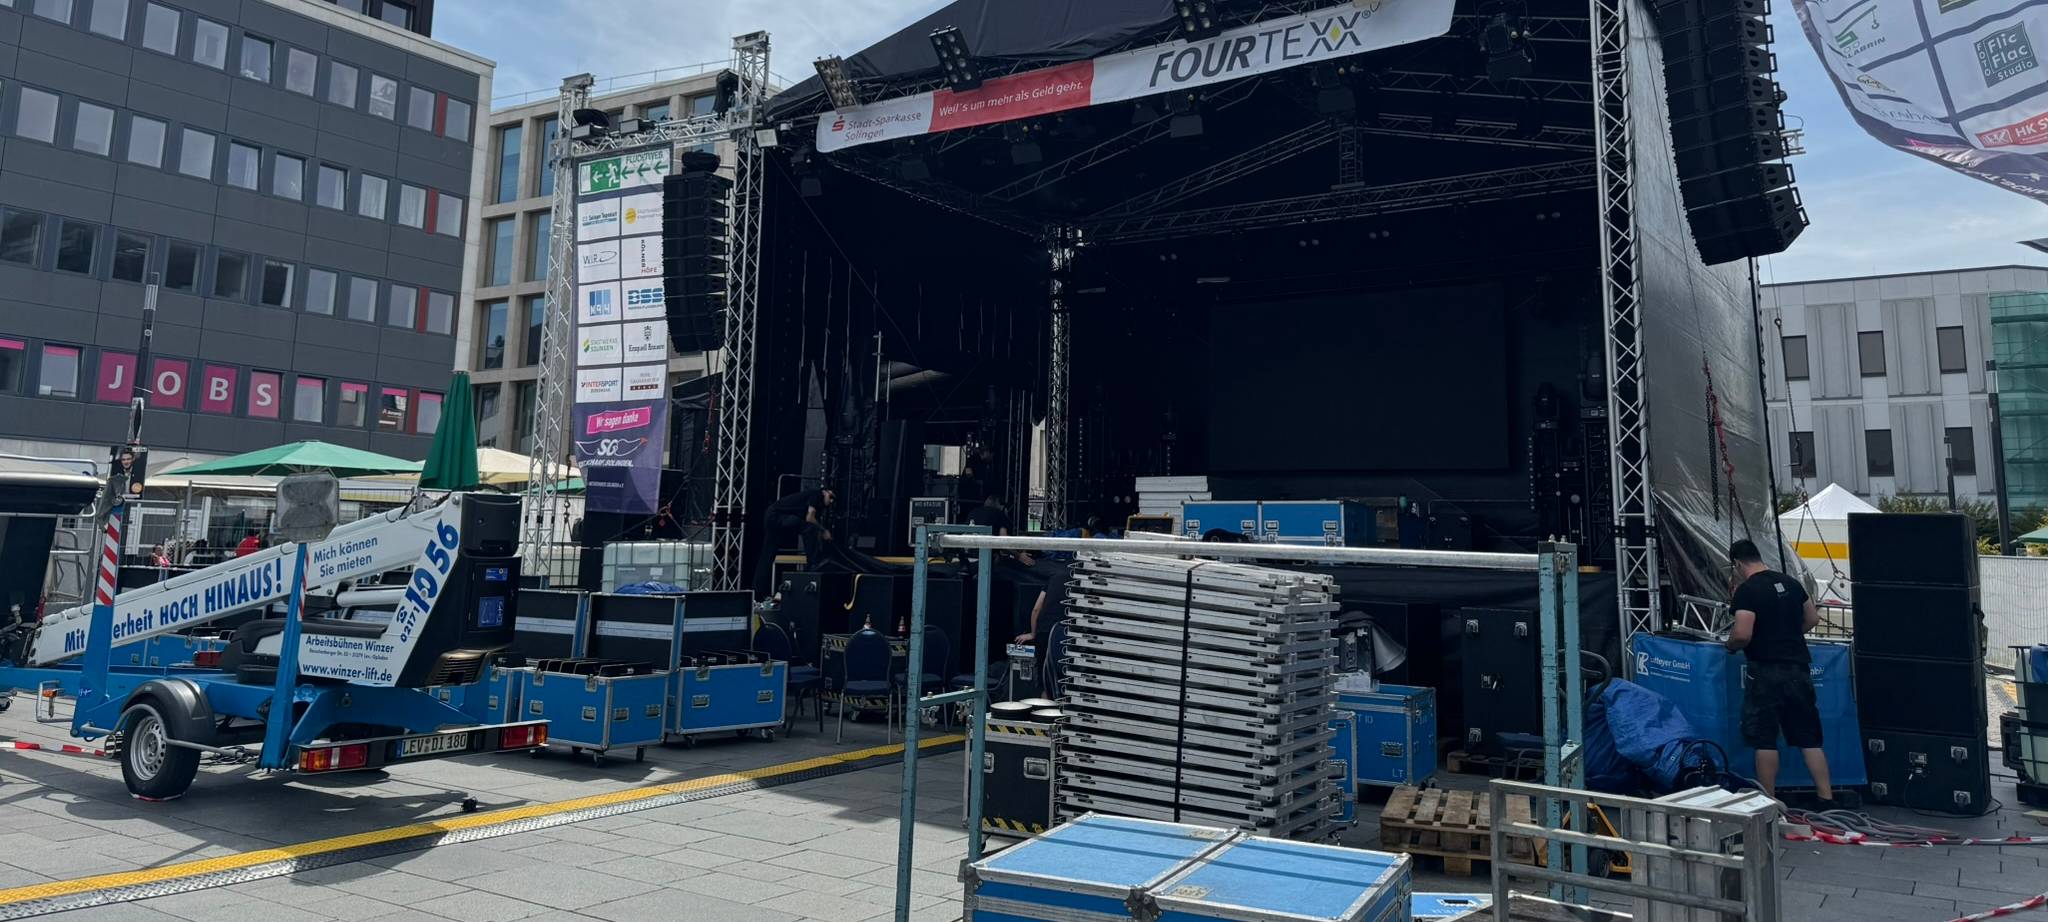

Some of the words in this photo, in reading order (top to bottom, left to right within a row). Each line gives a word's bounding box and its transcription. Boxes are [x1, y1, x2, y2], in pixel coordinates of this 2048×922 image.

[1149, 11, 1362, 88] FOURTEXX
[1987, 33, 2017, 53] Flic
[1976, 43, 1992, 77] FOTO
[1991, 45, 2028, 69] Flac
[1997, 60, 2033, 81] Studio
[970, 99, 986, 111] um
[987, 94, 1013, 107] mehr
[1015, 91, 1030, 102] als
[1031, 84, 1054, 98] Geld
[1056, 81, 1084, 96] geht.
[847, 112, 922, 131] Stadt-Sparkasse
[2015, 123, 2037, 137] HK
[844, 128, 884, 142] Solingen
[627, 287, 664, 305] BSS
[604, 415, 622, 429] sagen
[622, 411, 640, 425] danke
[313, 545, 337, 564] Mich
[338, 535, 379, 557] können
[319, 564, 335, 578] Sie
[336, 554, 373, 574] mieten
[400, 606, 420, 644] 02171
[424, 521, 459, 575] 56
[64, 629, 85, 653] Mit
[113, 608, 153, 639] erheit
[159, 593, 199, 626] HOCH
[305, 635, 363, 650] Arbeitsbühnen
[365, 640, 395, 653] Winzer
[302, 663, 393, 682] www.winzer-lift.de
[402, 739, 425, 755] LEV
[431, 736, 444, 751] DI
[446, 734, 467, 750] 180
[1392, 768, 1404, 778] LT
